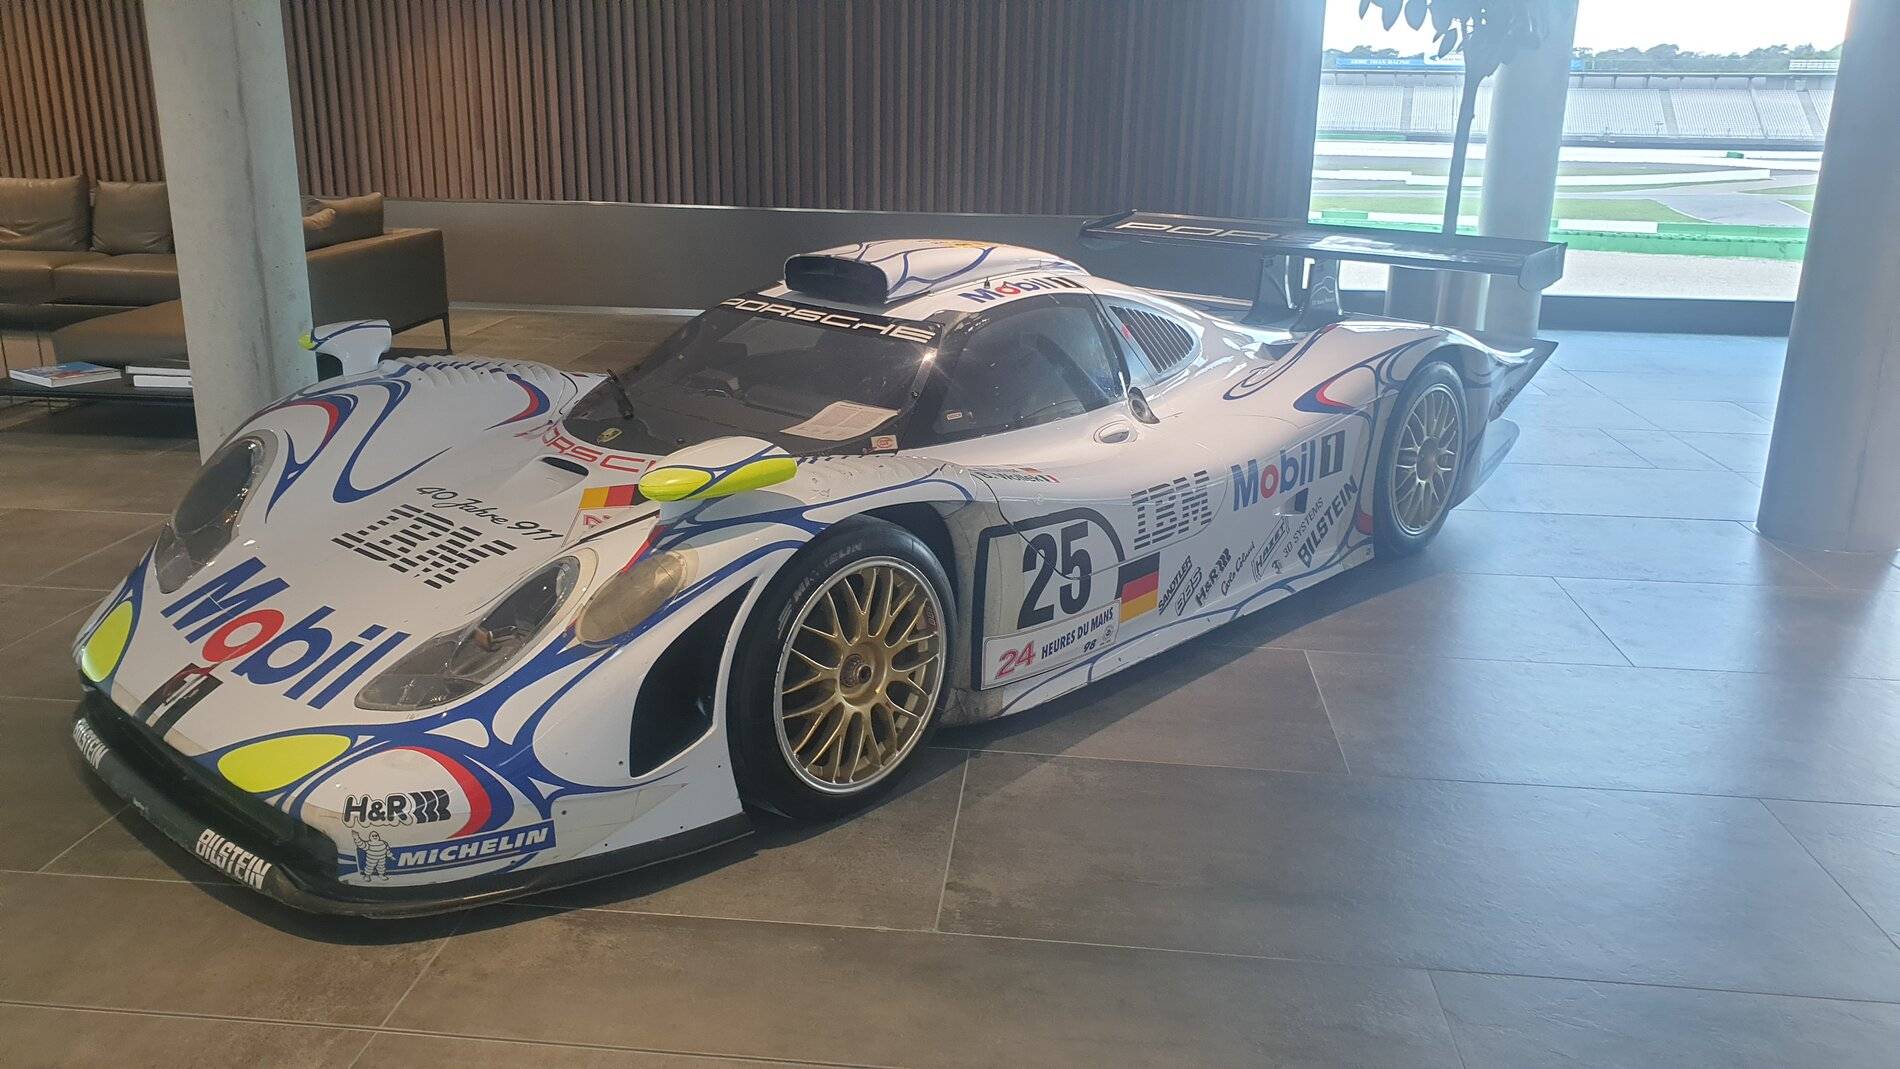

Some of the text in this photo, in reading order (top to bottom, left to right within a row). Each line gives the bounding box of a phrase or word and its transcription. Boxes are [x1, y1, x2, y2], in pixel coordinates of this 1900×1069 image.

[958, 277, 1057, 303] Mobil
[720, 298, 936, 344] PORSCHE
[513, 419, 656, 474] PORSC
[1231, 430, 1344, 511] Mobil 1
[416, 486, 564, 541] 40 Jahre 911
[1131, 470, 1213, 550] IBM
[1292, 497, 1324, 544] SYSTEMS
[1297, 475, 1359, 569] BILSTEIN
[331, 504, 517, 590] IBM
[1017, 521, 1092, 630] 25
[1158, 555, 1192, 612] SANDTLER
[160, 556, 412, 710] Mobil
[996, 640, 1035, 680] 24
[1041, 629, 1075, 659] HEURES
[1077, 623, 1089, 640] DU
[1090, 607, 1114, 632] MANS
[1083, 638, 1097, 653] 98
[343, 795, 411, 824] H&R
[195, 828, 272, 890] BILSTEIN
[397, 827, 549, 867] MICHELIN
